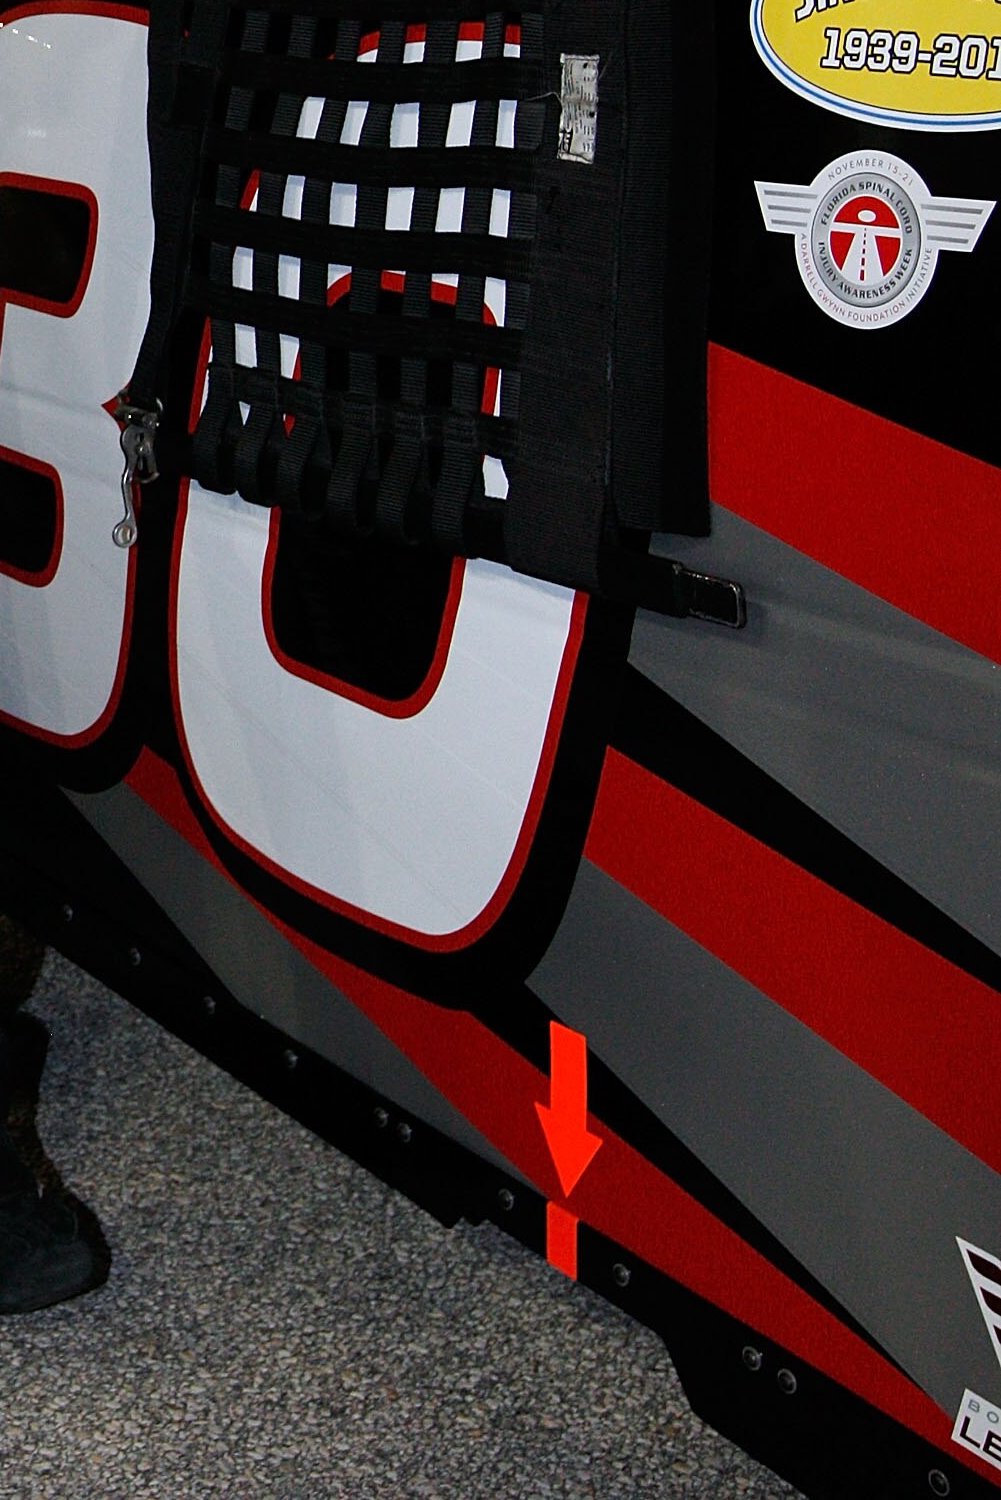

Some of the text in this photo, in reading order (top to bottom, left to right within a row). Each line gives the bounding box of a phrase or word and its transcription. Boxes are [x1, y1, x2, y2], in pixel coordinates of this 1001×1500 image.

[828, 157, 913, 186] NOVEMBER 15-21
[821, 181, 913, 235] FLORIDA SPINAL CORD
[801, 241, 819, 289] DARRELL
[817, 287, 846, 317] GWYNN
[847, 300, 906, 323] FOUNDATION
[906, 247, 933, 303] INITIATIVE
[818, 241, 913, 299] INJURY AWARENESS WEEK
